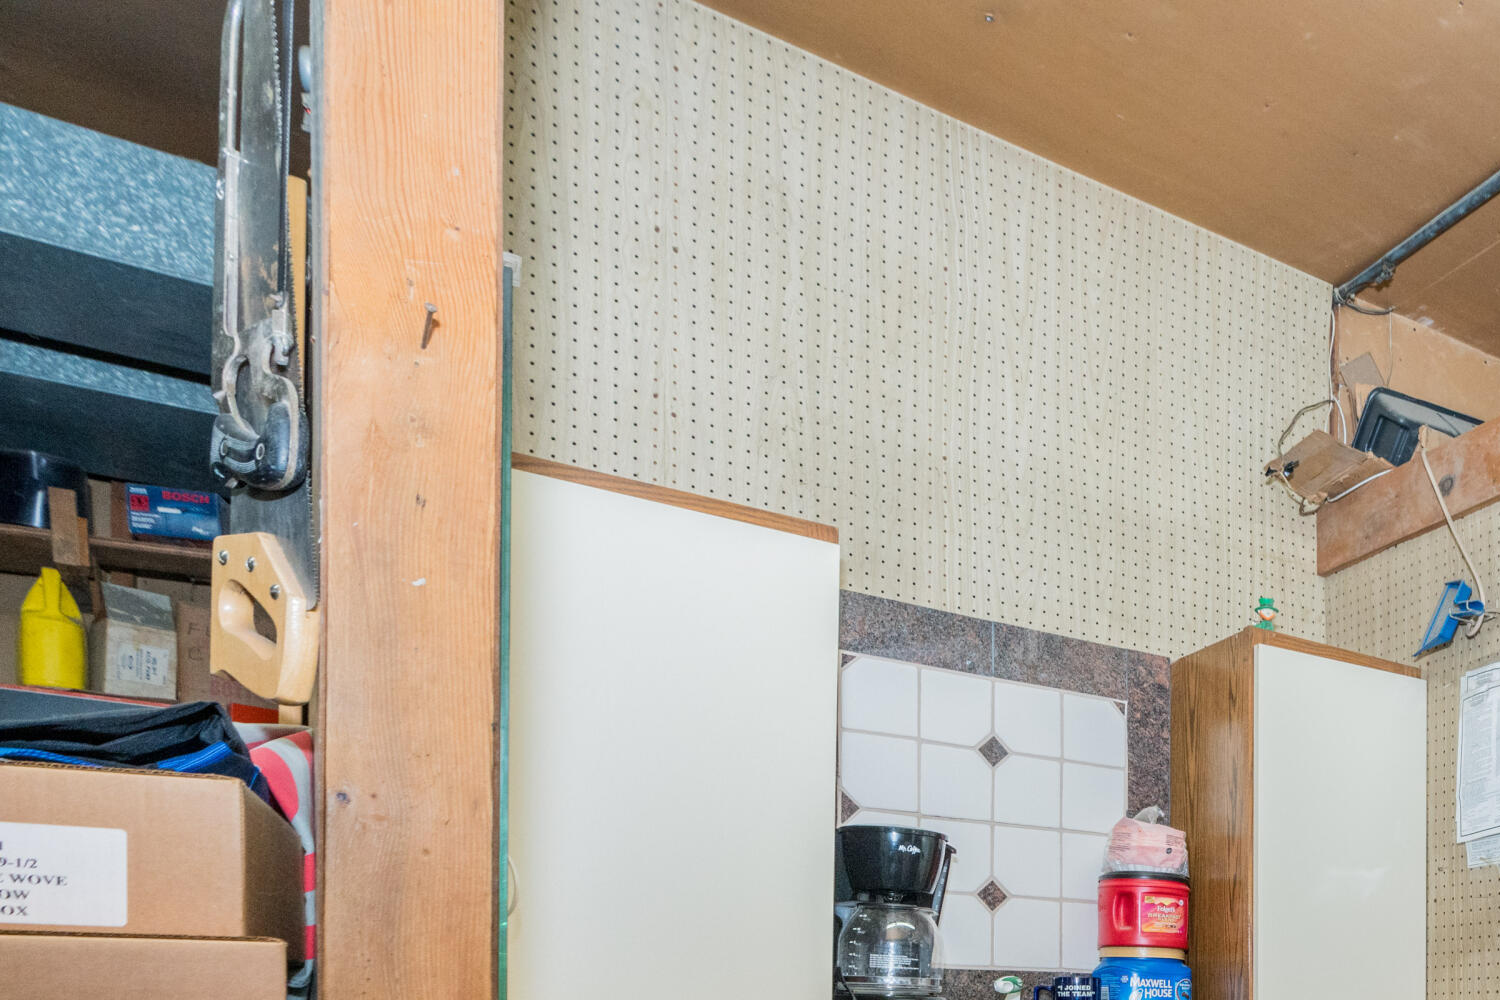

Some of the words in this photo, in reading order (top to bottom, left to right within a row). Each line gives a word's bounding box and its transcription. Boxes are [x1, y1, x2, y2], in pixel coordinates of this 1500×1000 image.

[161, 489, 210, 505] BOSCH
[9, 873, 68, 886] WOVE
[1130, 975, 1173, 989] MAXWELL
[1144, 988, 1173, 999] HOUSE
